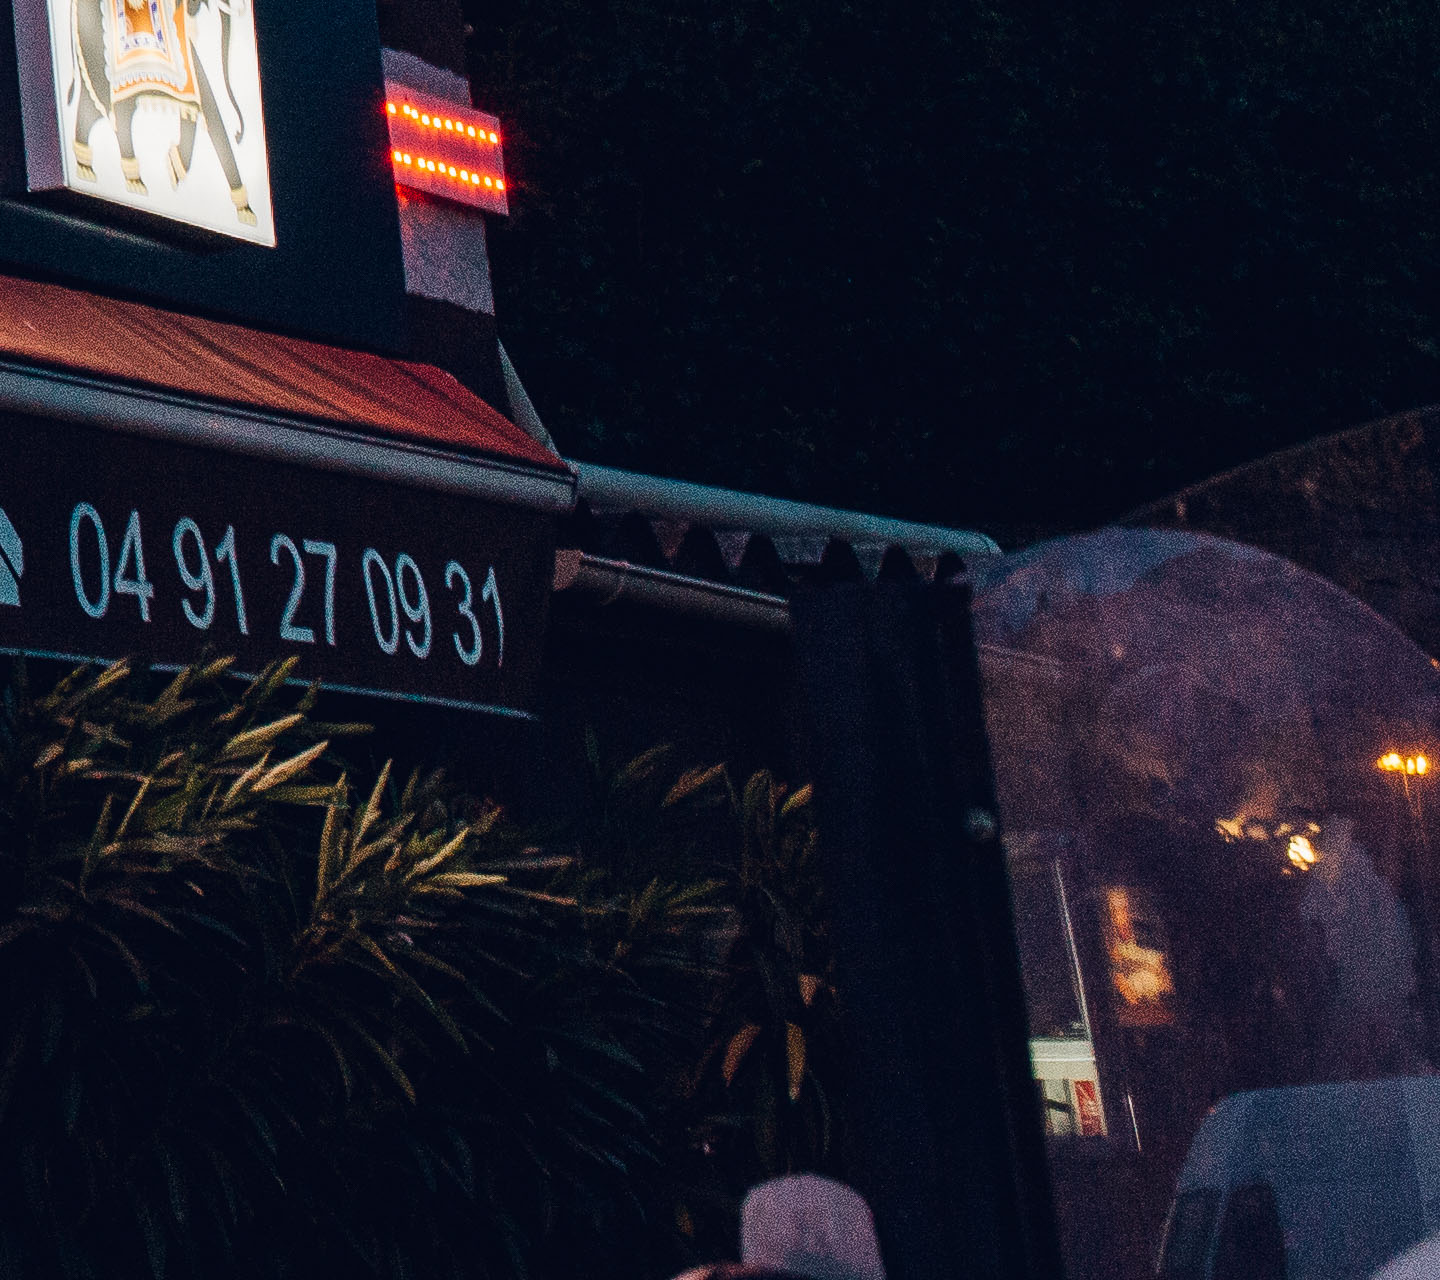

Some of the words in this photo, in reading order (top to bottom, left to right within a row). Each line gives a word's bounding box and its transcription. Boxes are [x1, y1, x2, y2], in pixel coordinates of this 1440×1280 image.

[69, 500, 155, 623] 04
[172, 515, 249, 636] 91
[270, 532, 337, 646] 27
[362, 547, 432, 660] 09
[444, 559, 505, 668] 31
